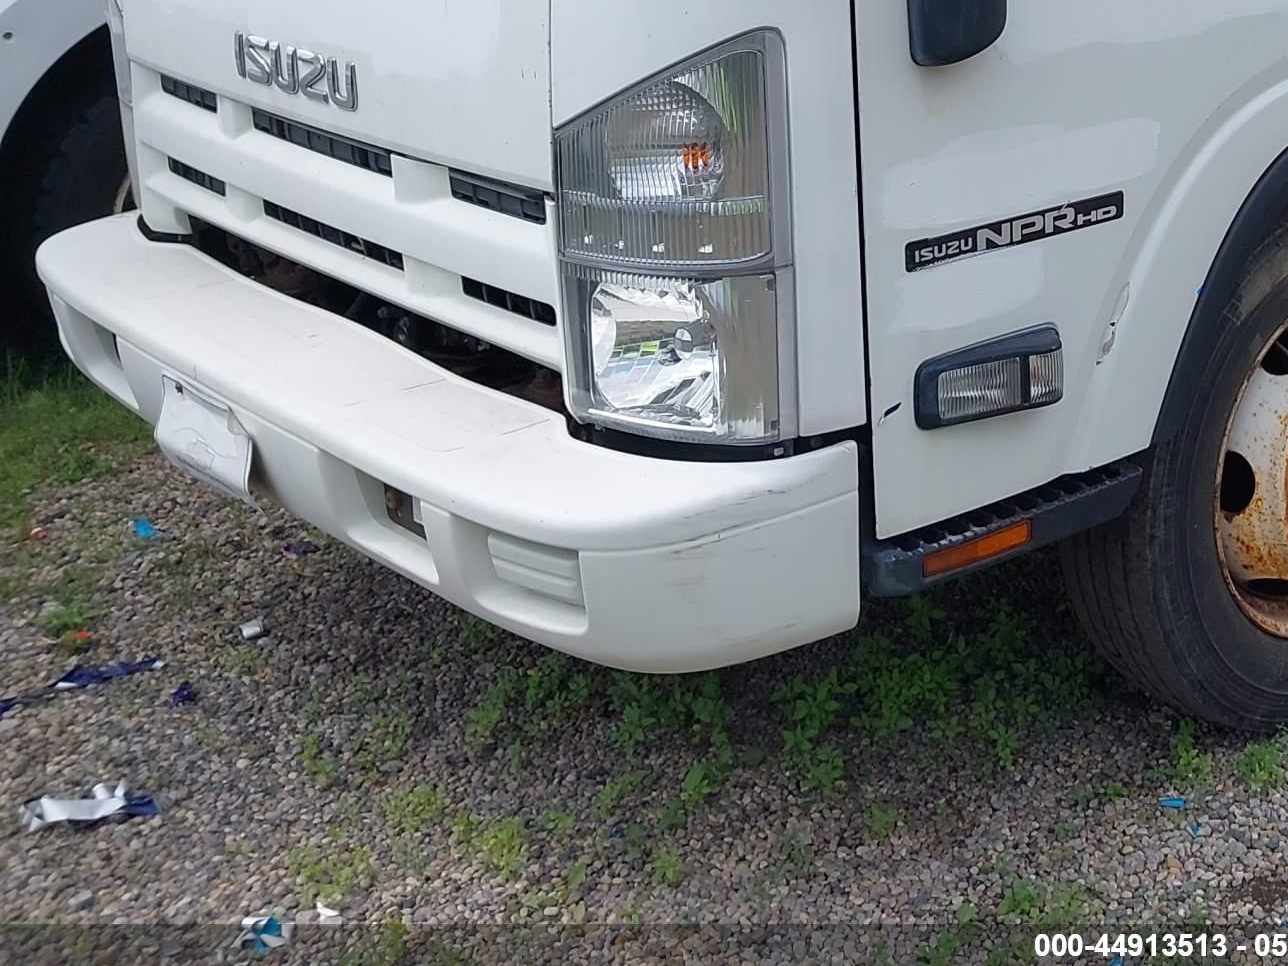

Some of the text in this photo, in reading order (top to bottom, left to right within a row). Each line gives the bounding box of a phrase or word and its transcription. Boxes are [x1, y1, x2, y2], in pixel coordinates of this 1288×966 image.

[233, 29, 359, 113] ISUZU
[914, 205, 1118, 264] ISUZU NPR HD
